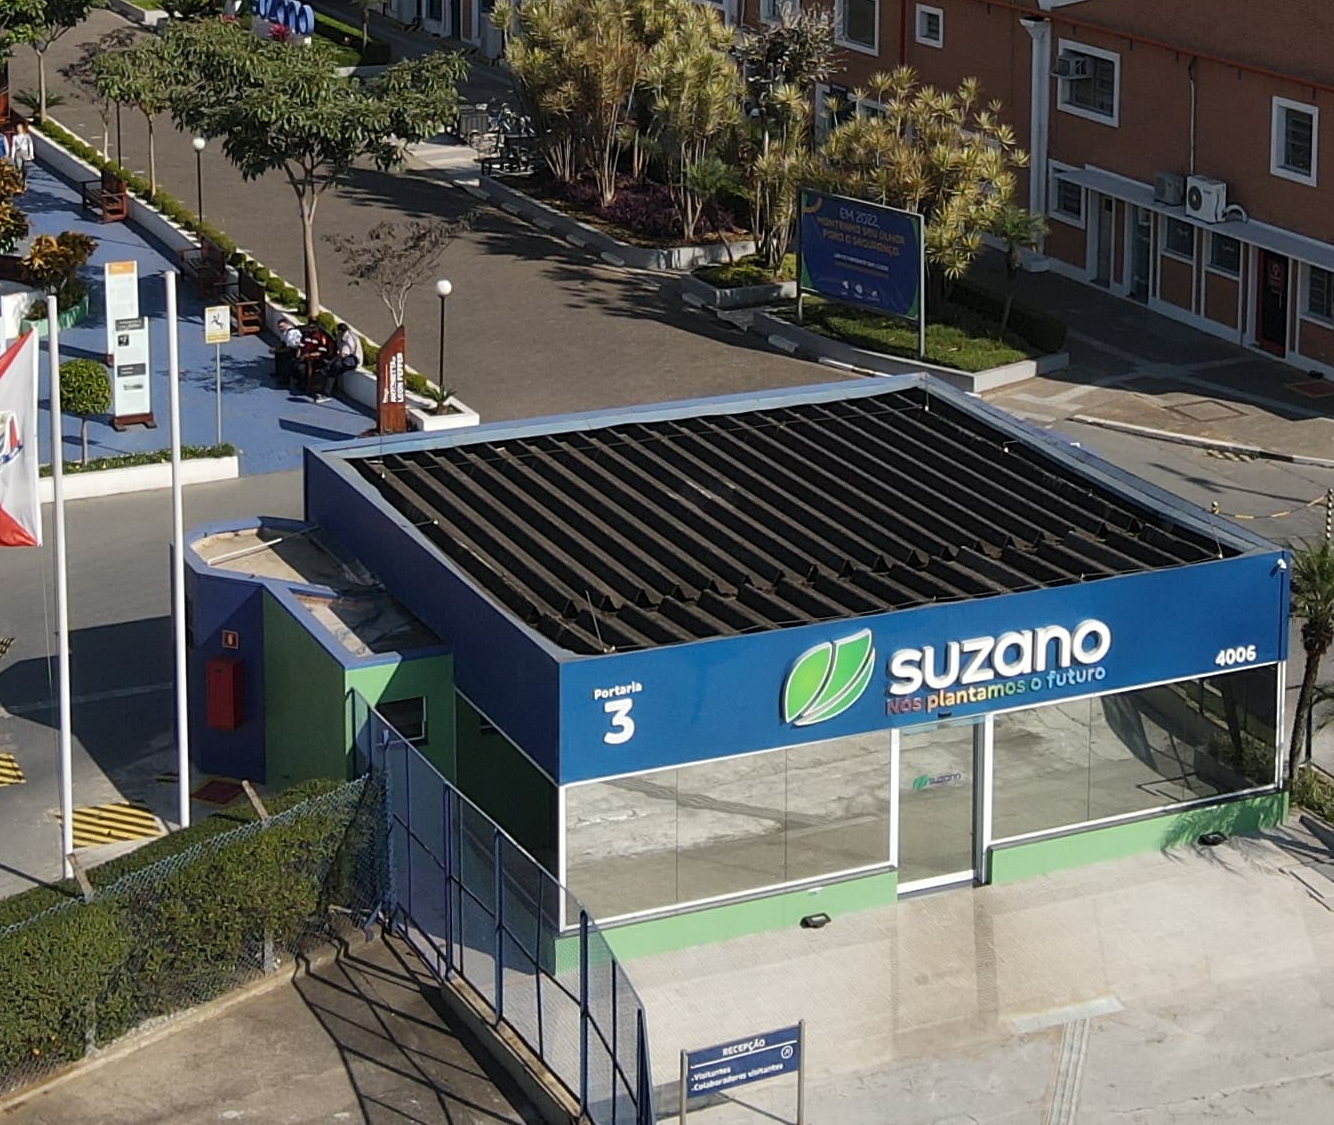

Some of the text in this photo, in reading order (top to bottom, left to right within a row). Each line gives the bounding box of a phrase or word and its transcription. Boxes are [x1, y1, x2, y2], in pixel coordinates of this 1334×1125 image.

[888, 619, 1111, 695] suzano
[1215, 644, 1257, 666] 4006
[593, 681, 643, 700] Portaria
[885, 665, 1106, 716] Nós plantamos o futuro
[603, 697, 636, 745] 3
[722, 1038, 766, 1056] RECEPÇÃO
